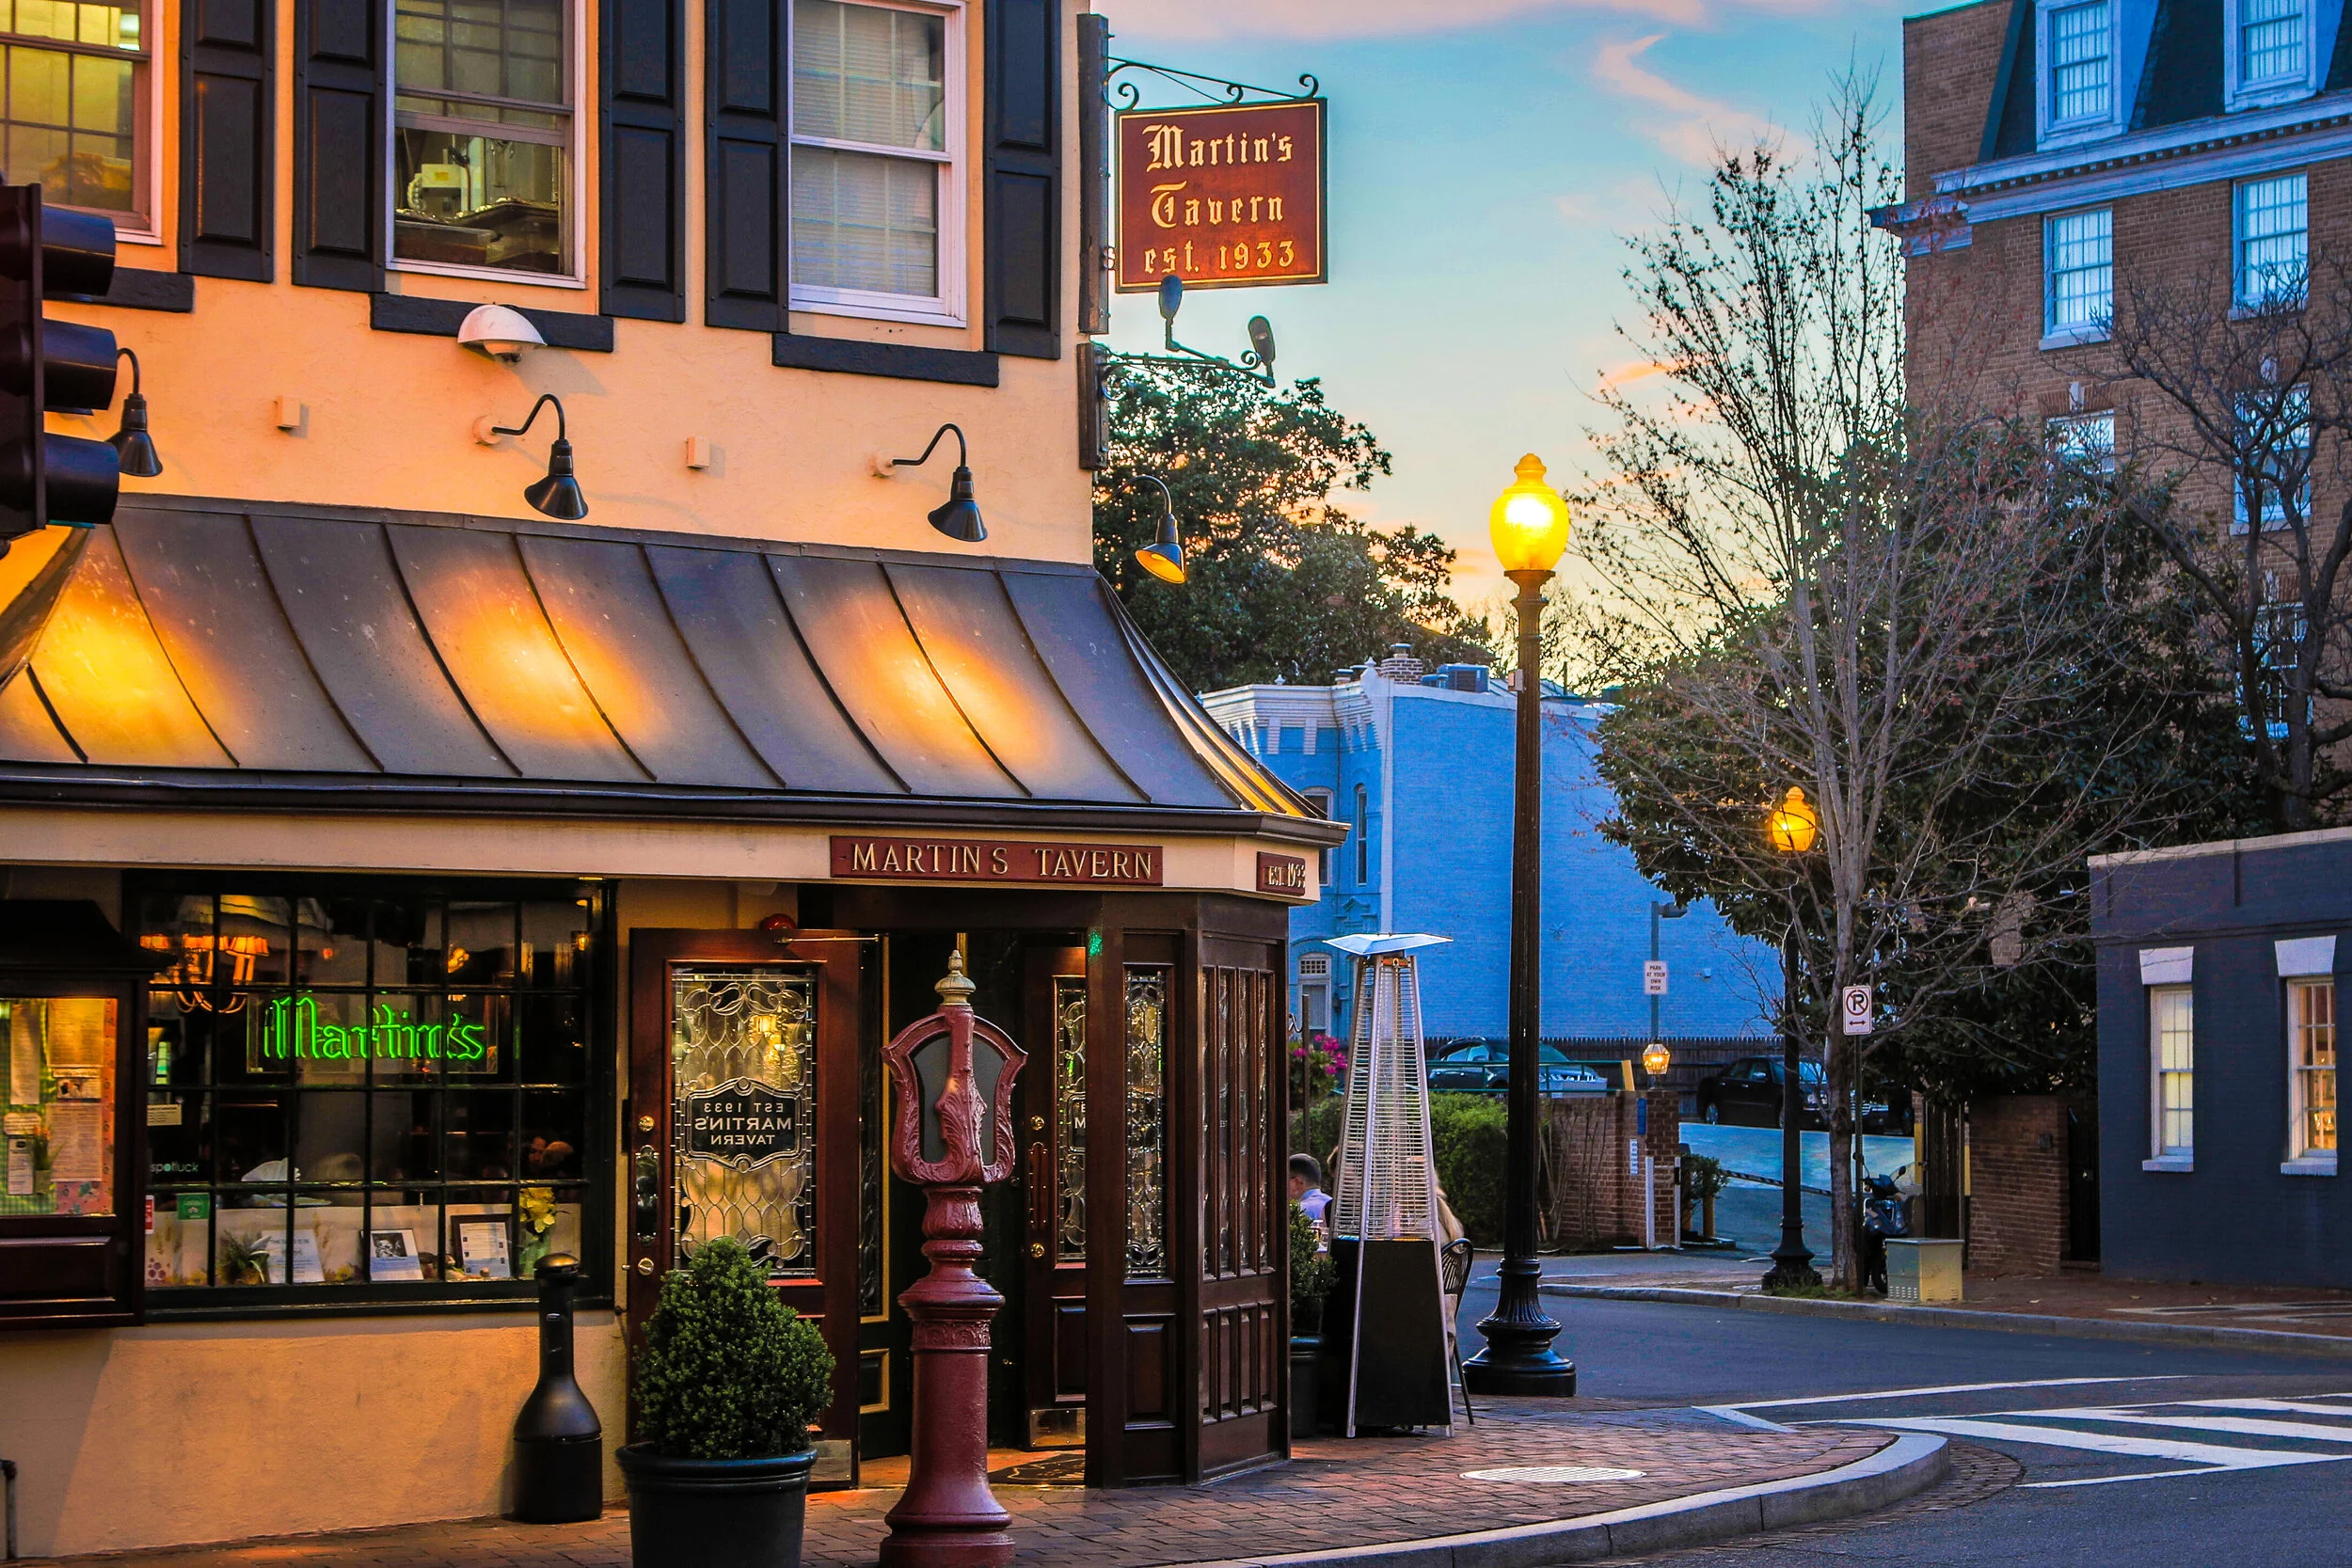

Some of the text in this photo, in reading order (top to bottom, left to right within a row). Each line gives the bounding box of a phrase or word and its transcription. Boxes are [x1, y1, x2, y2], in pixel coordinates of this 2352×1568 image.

[1142, 124, 1294, 173] Martin's
[1150, 180, 1284, 229] Tavern
[1144, 240, 1295, 275] est. 1933
[1035, 848, 1152, 879] TAVERN
[263, 996, 485, 1060] Martin's
